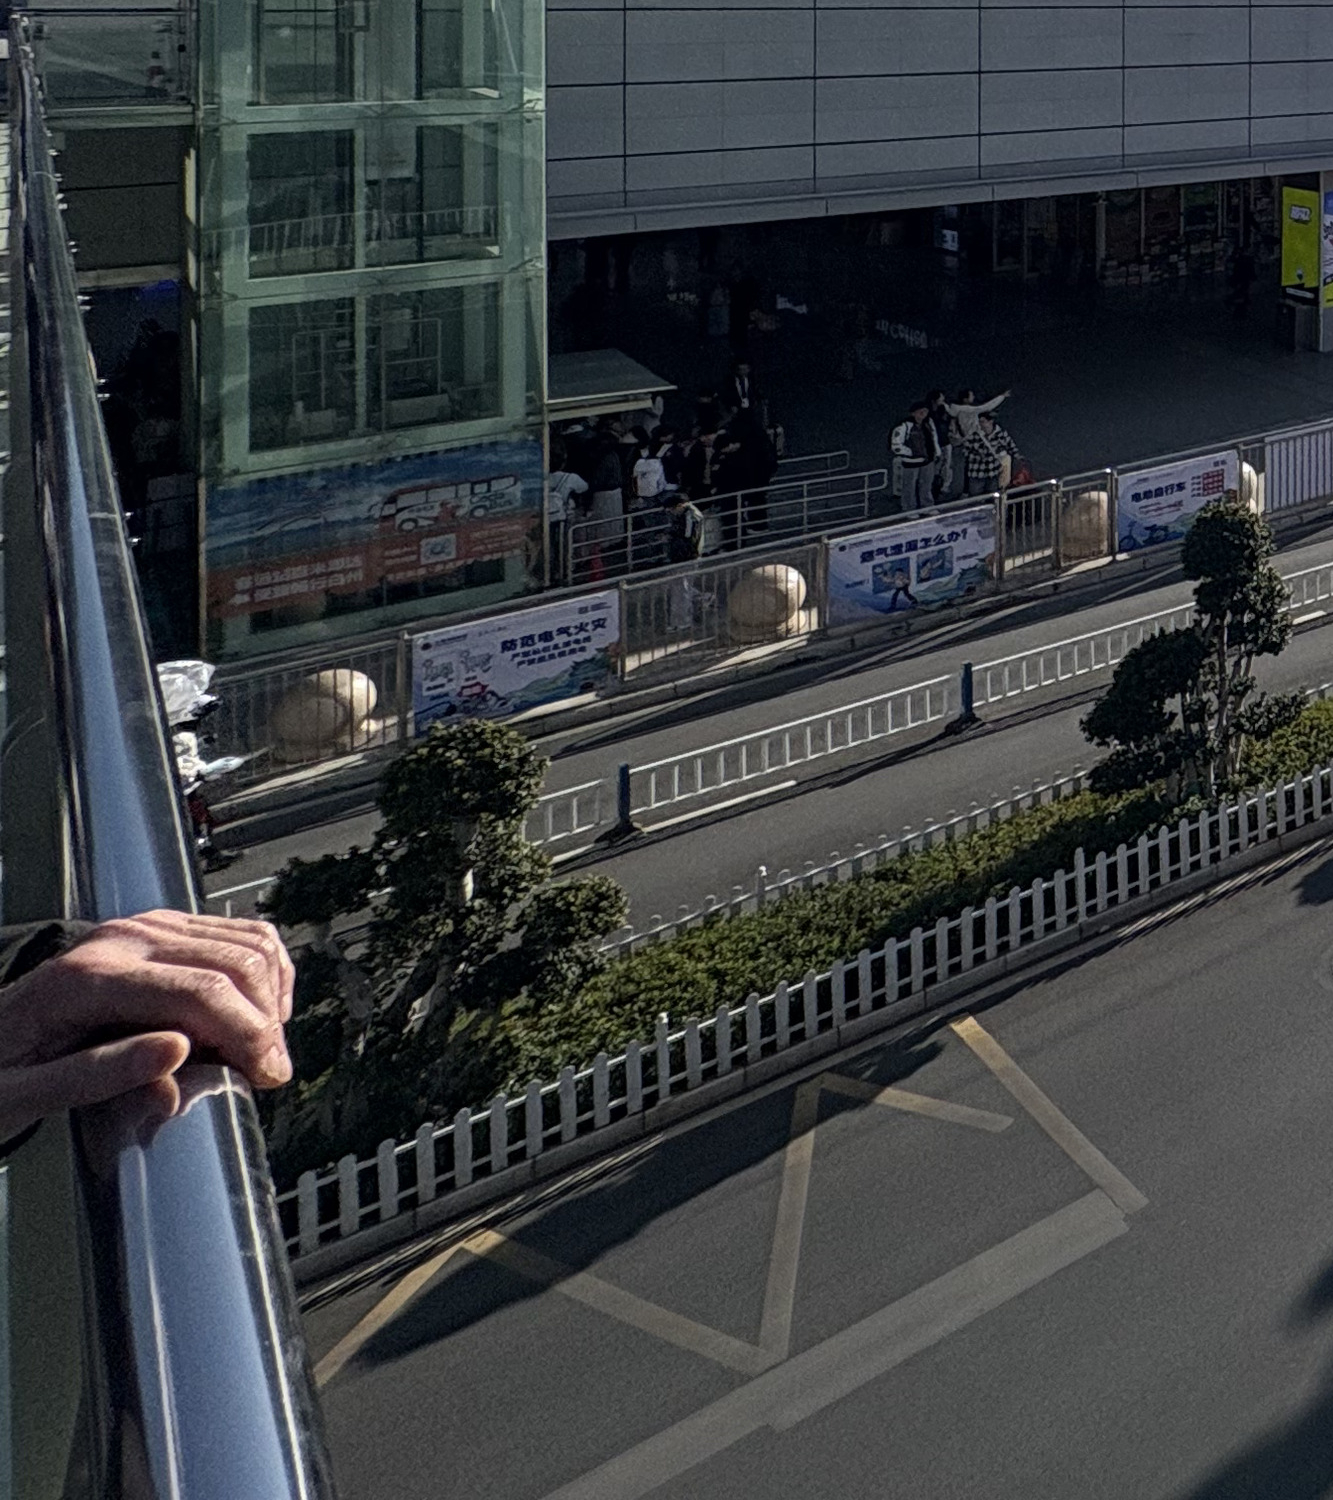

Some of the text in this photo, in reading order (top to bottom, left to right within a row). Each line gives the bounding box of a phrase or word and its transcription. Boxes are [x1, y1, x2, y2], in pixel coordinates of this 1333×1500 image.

[501, 616, 609, 654] 防范电气火灾
